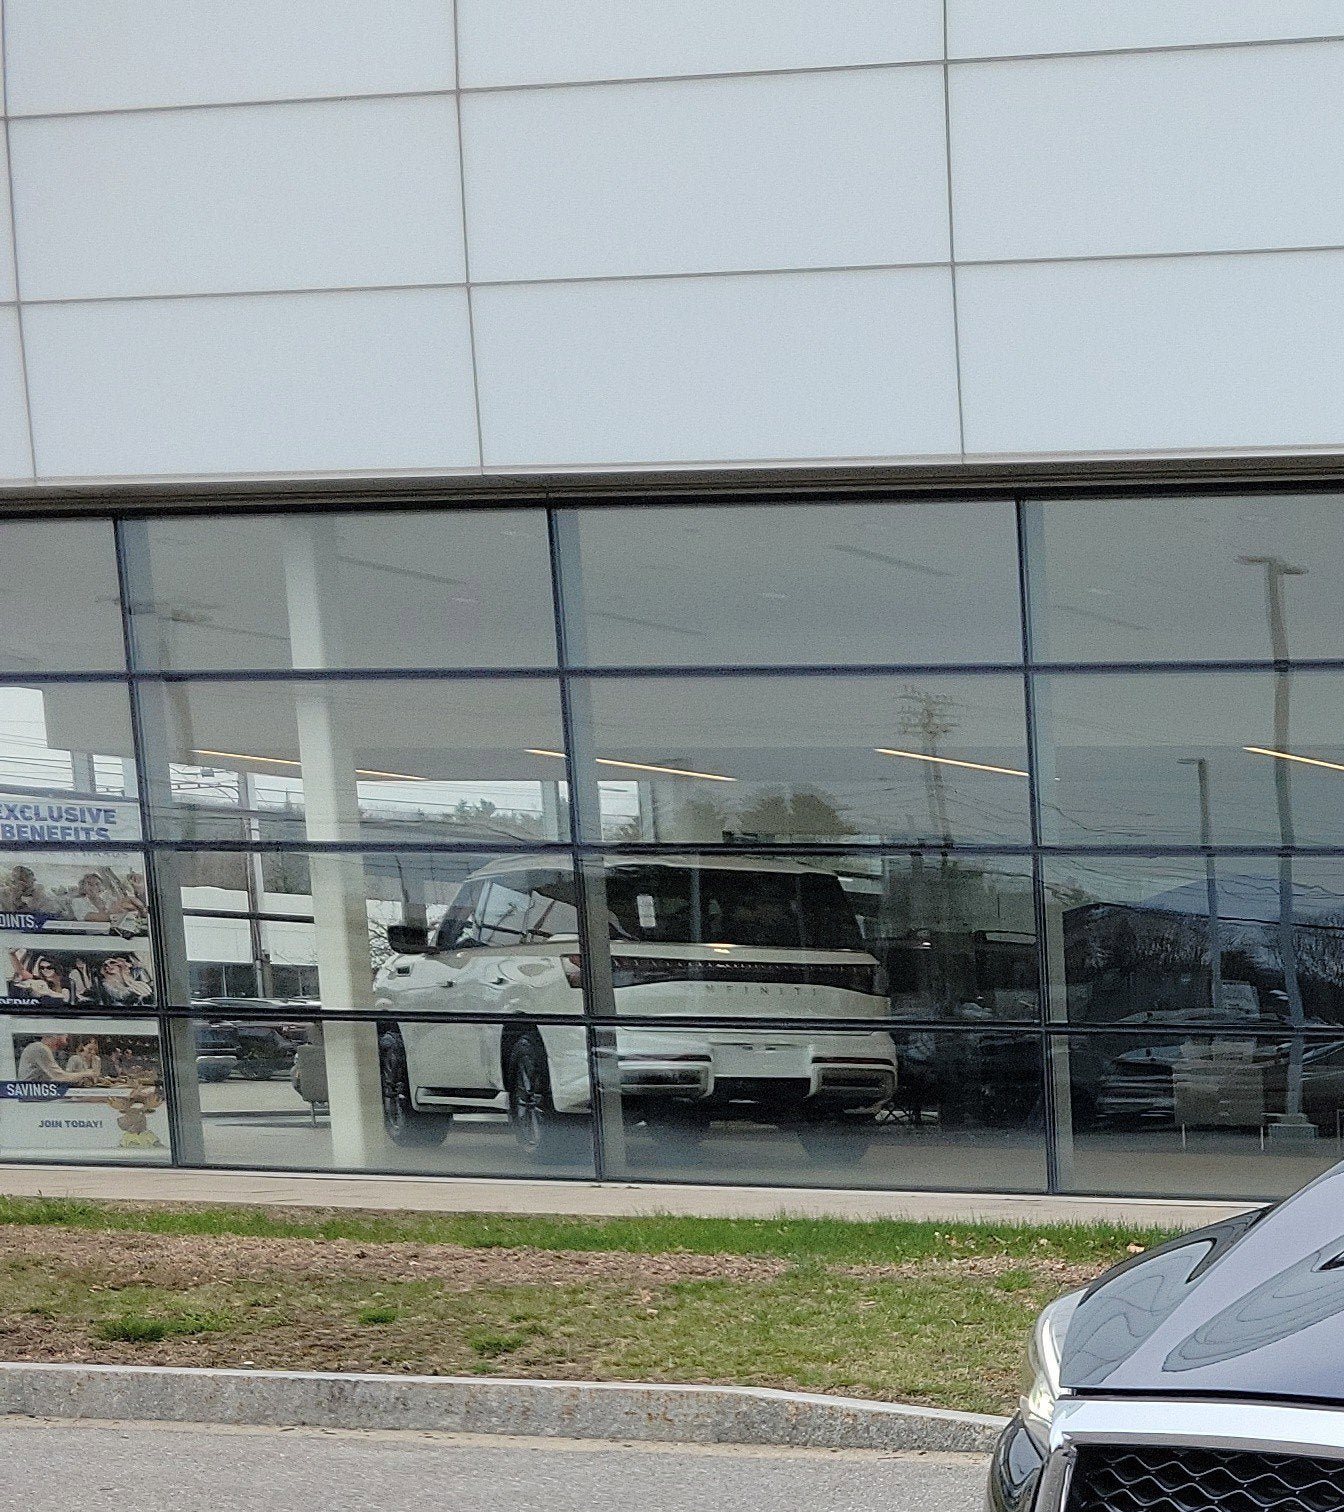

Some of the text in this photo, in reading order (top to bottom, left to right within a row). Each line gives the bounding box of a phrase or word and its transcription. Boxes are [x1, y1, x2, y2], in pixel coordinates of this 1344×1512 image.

[0, 823, 111, 841] BENEFITS
[688, 983, 819, 998] NFINITI
[6, 1083, 61, 1097] SAVINGS.
[38, 1119, 103, 1129] JOIN TODAY!
